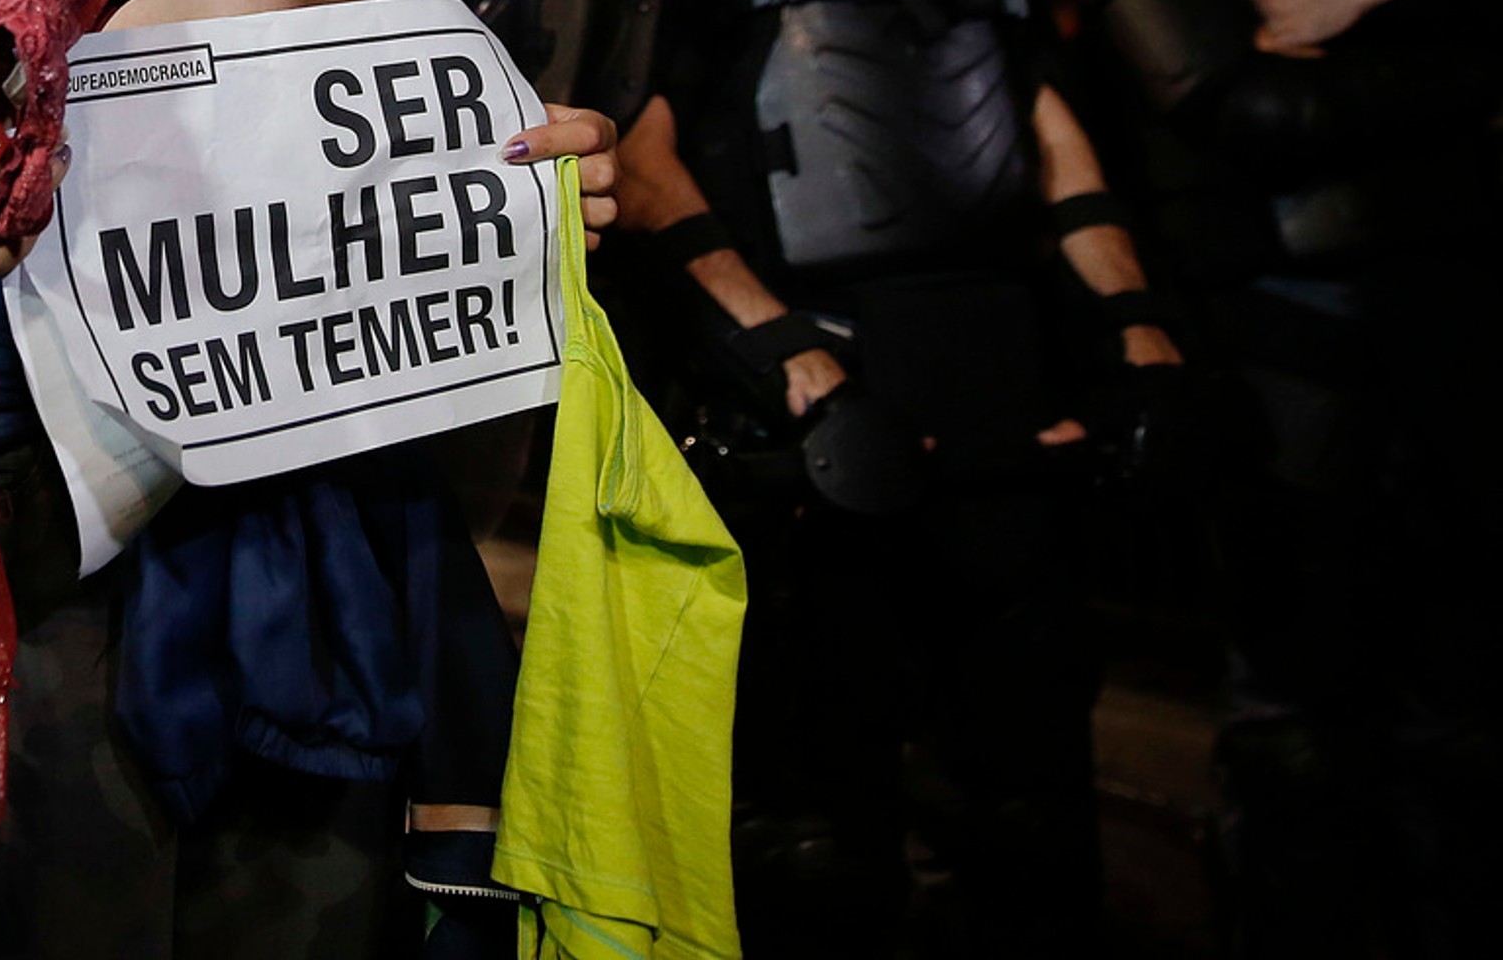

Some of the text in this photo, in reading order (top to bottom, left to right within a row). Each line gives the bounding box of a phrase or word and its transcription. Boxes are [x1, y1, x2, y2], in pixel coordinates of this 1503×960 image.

[314, 56, 495, 169] SER
[99, 170, 517, 331] MULHER
[131, 279, 520, 421] SEM TEMER!
